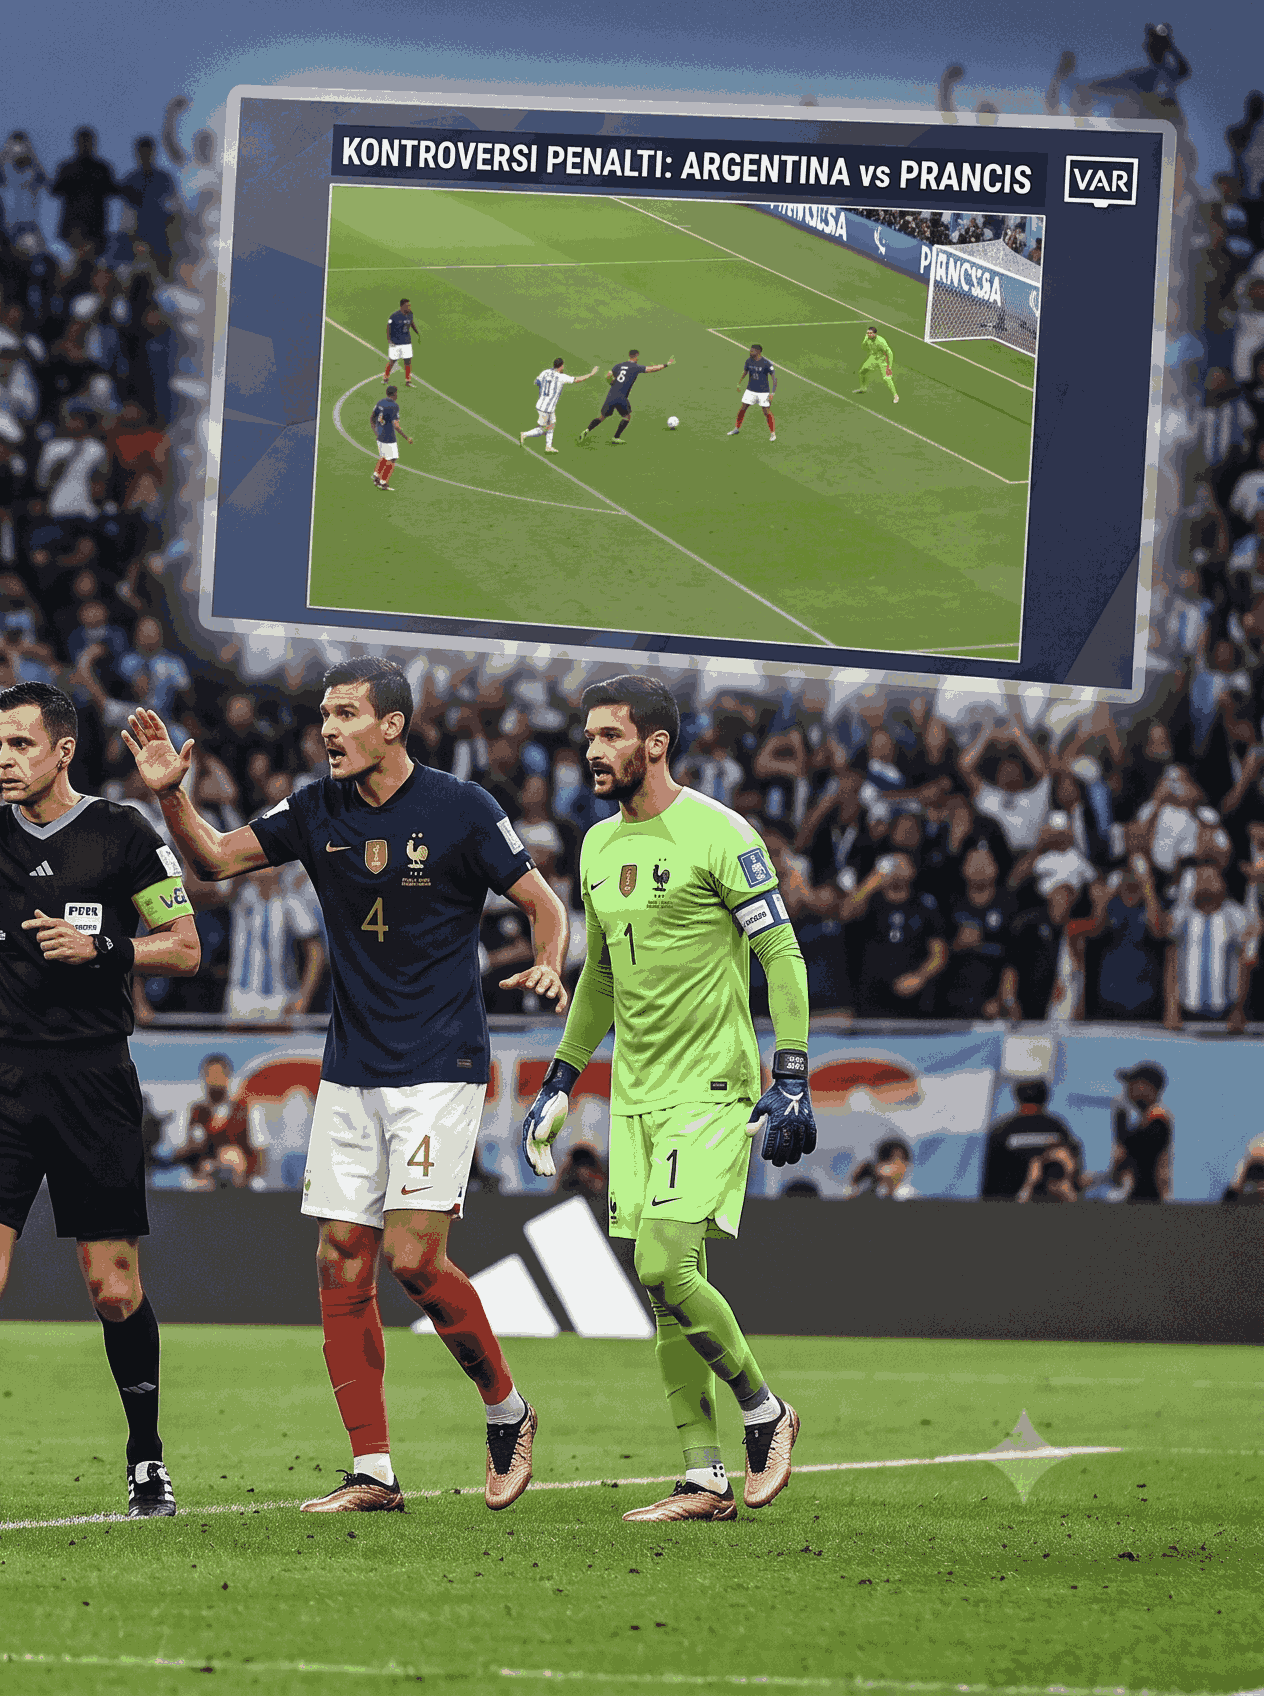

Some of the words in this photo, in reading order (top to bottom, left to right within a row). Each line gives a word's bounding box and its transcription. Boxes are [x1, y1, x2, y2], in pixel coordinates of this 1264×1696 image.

[342, 136, 537, 173] KONTROVERSI
[546, 145, 673, 179] PENALTI:
[680, 151, 851, 187] ARGENTINA
[859, 164, 891, 189] vs
[899, 160, 1033, 194] PRANCIS
[1073, 167, 1129, 193] VAR
[361, 897, 389, 942] 4
[623, 923, 637, 966] 1
[407, 1134, 435, 1177] 4
[666, 1148, 678, 1189] 1
